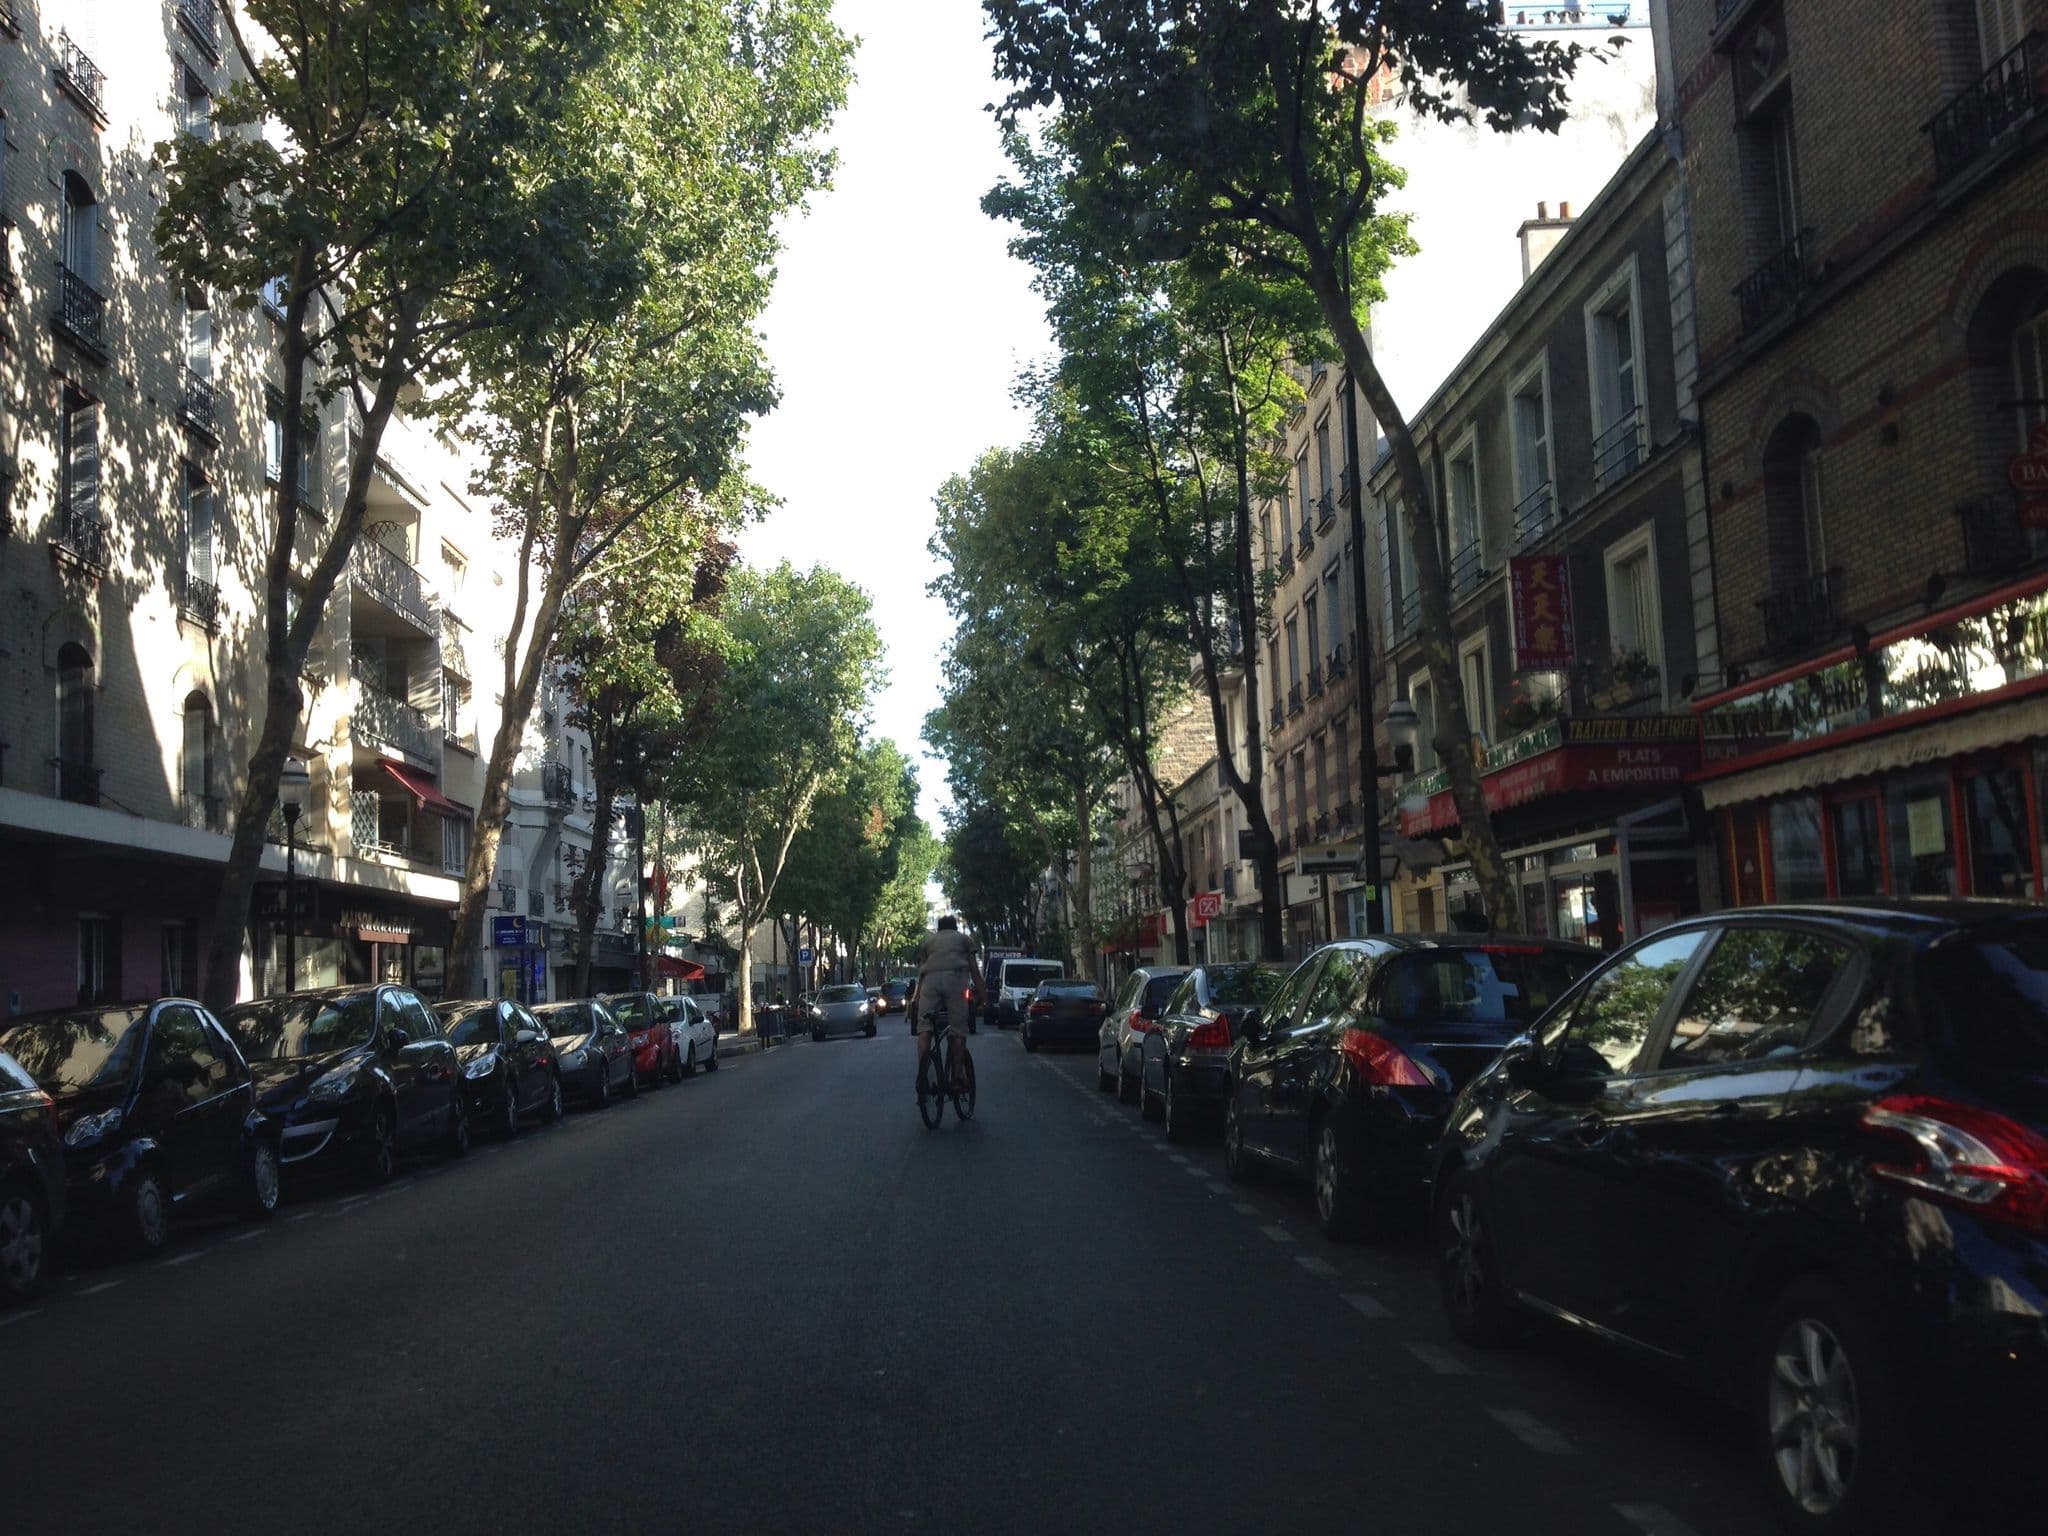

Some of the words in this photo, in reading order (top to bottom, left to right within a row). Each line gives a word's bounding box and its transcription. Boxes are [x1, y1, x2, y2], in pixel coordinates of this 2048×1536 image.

[1568, 719, 1627, 739] TRAITEUR
[1631, 718, 1697, 738] ASIATIQUE
[1616, 747, 1661, 764] PLATS
[1587, 771, 1599, 785] A
[1602, 766, 1680, 784] EMPORTER
